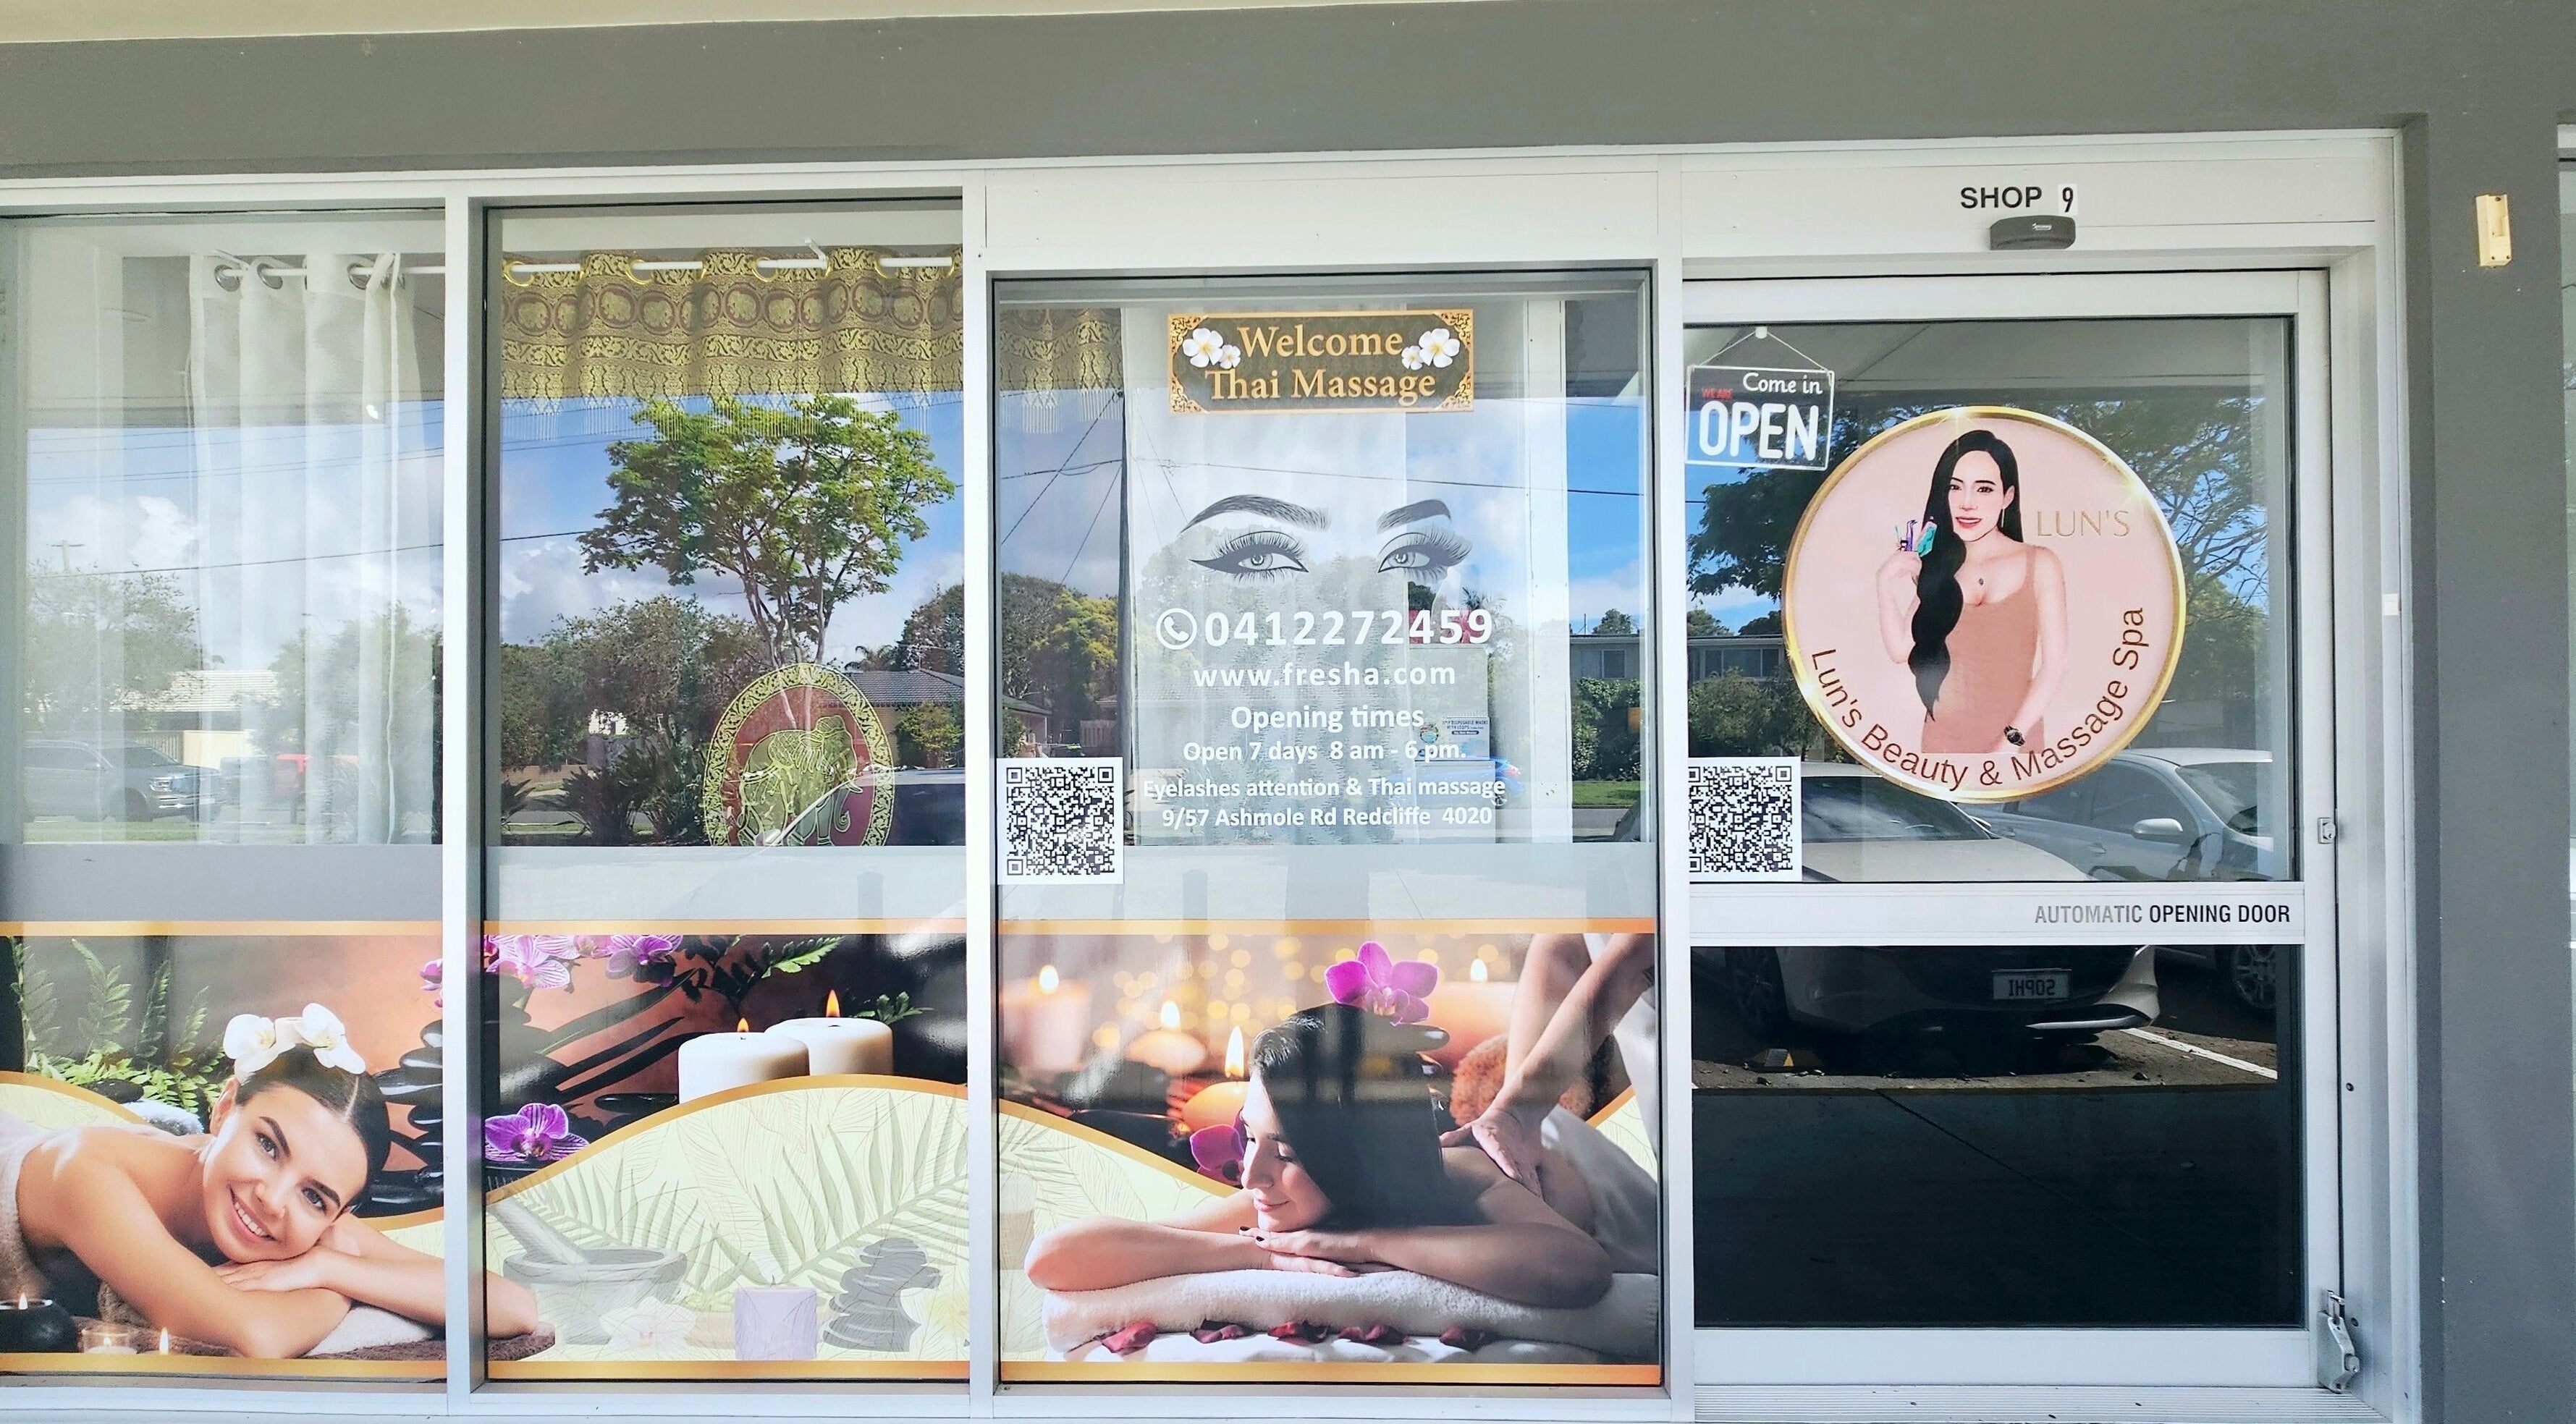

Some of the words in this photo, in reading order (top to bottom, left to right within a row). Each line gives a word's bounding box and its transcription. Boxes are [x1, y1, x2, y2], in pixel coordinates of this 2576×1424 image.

[1961, 187, 2043, 208] SHOP
[2063, 187, 2074, 213] 9
[1237, 323, 1403, 357] Welcome
[1205, 368, 1280, 400] Thai
[1292, 368, 1436, 406] Massage
[1702, 389, 1717, 399] WE
[1718, 389, 1733, 400] ARE
[1743, 372, 1796, 394] Come
[1802, 375, 1823, 394] in
[1699, 400, 1820, 462] OPEN
[2037, 510, 2132, 538] LUN'S
[1205, 609, 1492, 646] 0412272459
[1194, 661, 1456, 687] www.fresha.com
[1812, 649, 1863, 728] Lun's
[1861, 723, 1969, 792] Beauty
[1980, 760, 2003, 785] &
[2011, 679, 2129, 781] Massage
[2113, 606, 2150, 670] Spa
[1231, 705, 1343, 733] Opening
[1350, 705, 1424, 728] times
[1183, 742, 1242, 764] Open
[1249, 742, 1262, 760] 7
[1268, 741, 1317, 765] days
[1330, 742, 1343, 760] 8
[1350, 746, 1384, 760] am
[1404, 741, 1417, 760] 6
[1424, 745, 1466, 763] pm.
[1144, 779, 1241, 801] Eyelashes
[1246, 779, 1340, 797] attention
[1346, 779, 1363, 796] &
[1368, 778, 1411, 796] Thai
[1419, 780, 1506, 801] massage
[1162, 808, 1209, 831] 9/57
[1215, 808, 1304, 827] Ashmole
[1310, 807, 1337, 826] Rd
[1343, 807, 1431, 826] Redcliffe
[1442, 806, 1492, 824] 4020
[2035, 904, 2142, 923] AUTOMATIC
[2149, 904, 2231, 923] OPENING
[2238, 904, 2290, 923] DOOR
